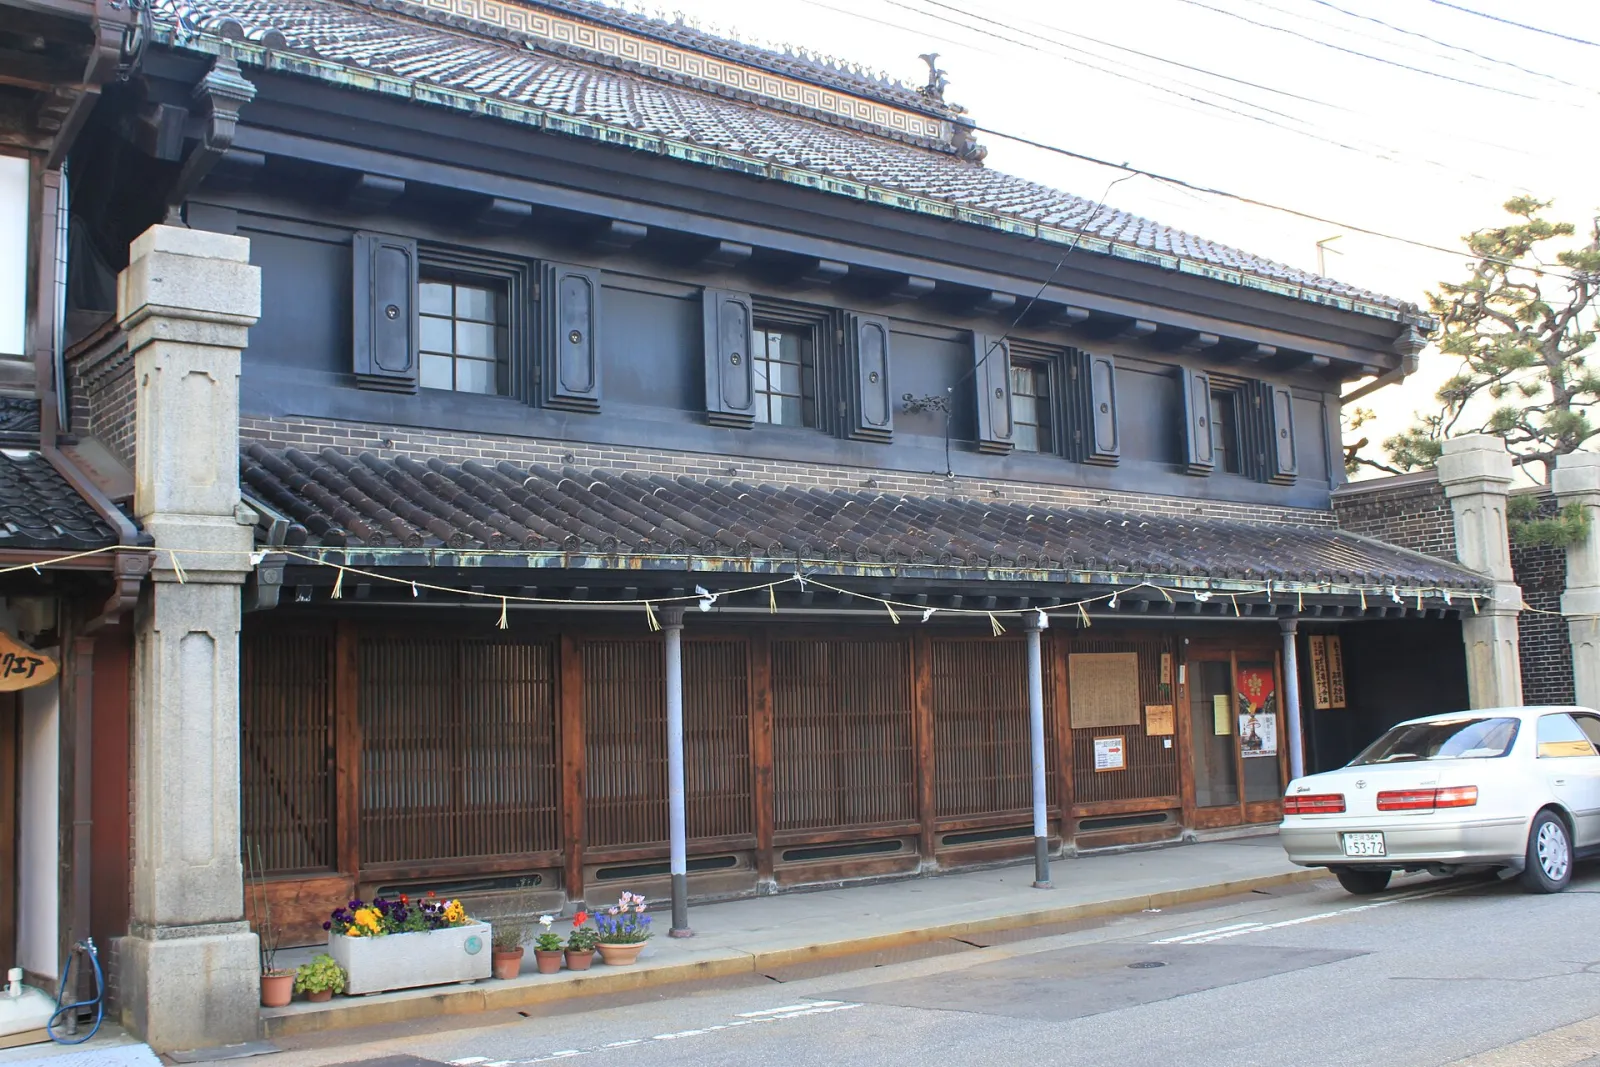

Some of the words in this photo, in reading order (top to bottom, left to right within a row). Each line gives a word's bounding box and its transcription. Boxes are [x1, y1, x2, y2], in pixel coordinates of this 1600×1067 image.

[0, 652, 44, 679] クエア
[1353, 841, 1384, 854] 53-72
